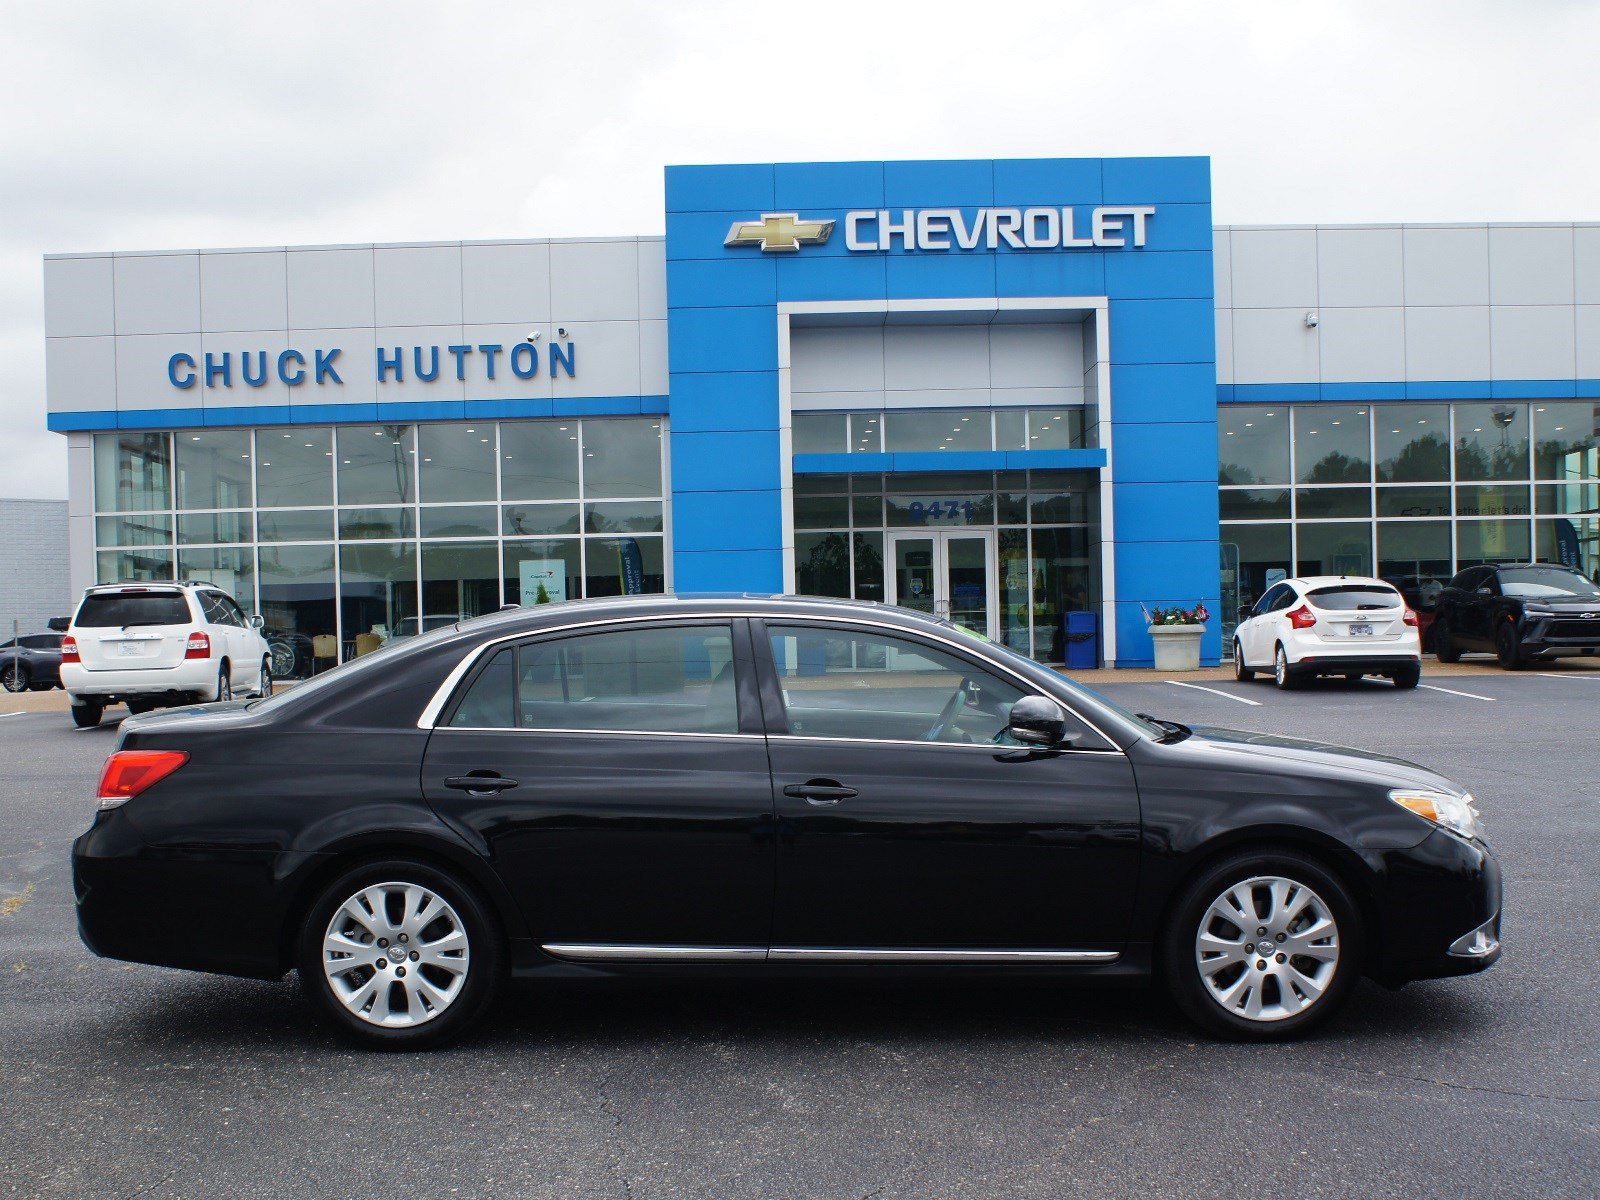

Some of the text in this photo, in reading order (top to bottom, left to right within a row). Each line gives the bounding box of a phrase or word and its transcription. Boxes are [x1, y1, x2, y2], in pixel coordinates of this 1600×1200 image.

[845, 206, 1156, 251] CHEVROLET
[168, 342, 576, 388] CHUCK HUTTON
[909, 500, 974, 520] 9471
